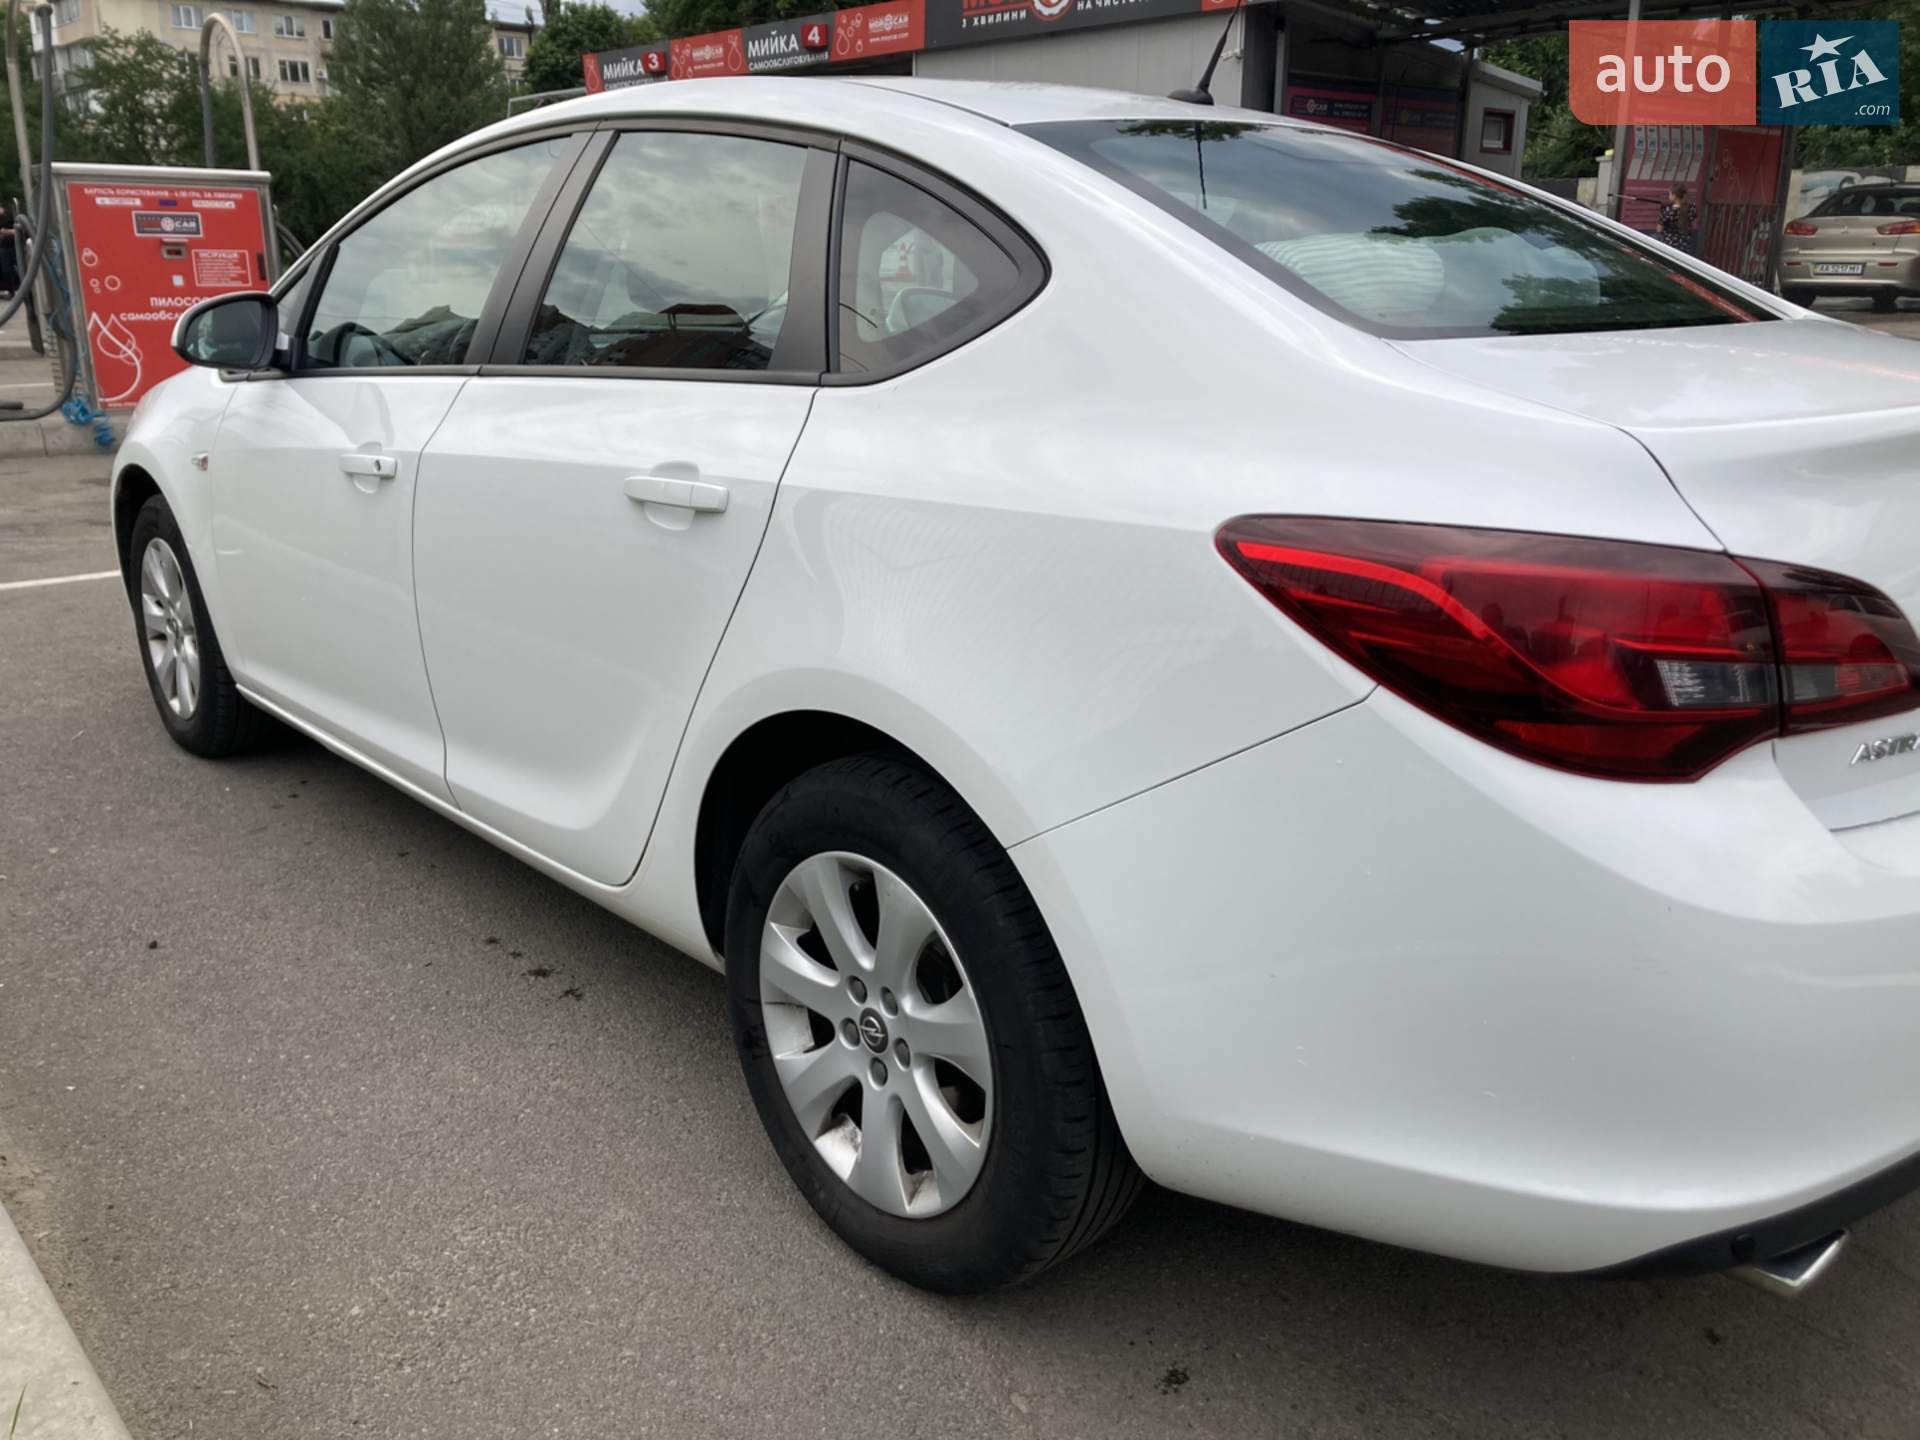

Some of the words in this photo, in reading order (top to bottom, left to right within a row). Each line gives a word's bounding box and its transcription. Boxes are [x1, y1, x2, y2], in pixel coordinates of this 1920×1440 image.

[1077, 0, 1093, 11] НА
[973, 9, 1027, 26] ХВИЛИНИ
[807, 25, 821, 44] 4
[747, 30, 799, 58] МИЙКА
[603, 57, 645, 80] МИЙКА
[648, 52, 660, 70] 3
[748, 51, 829, 71] САМООБСЛУГОВУВАННЯ
[120, 311, 184, 321] самообсл
